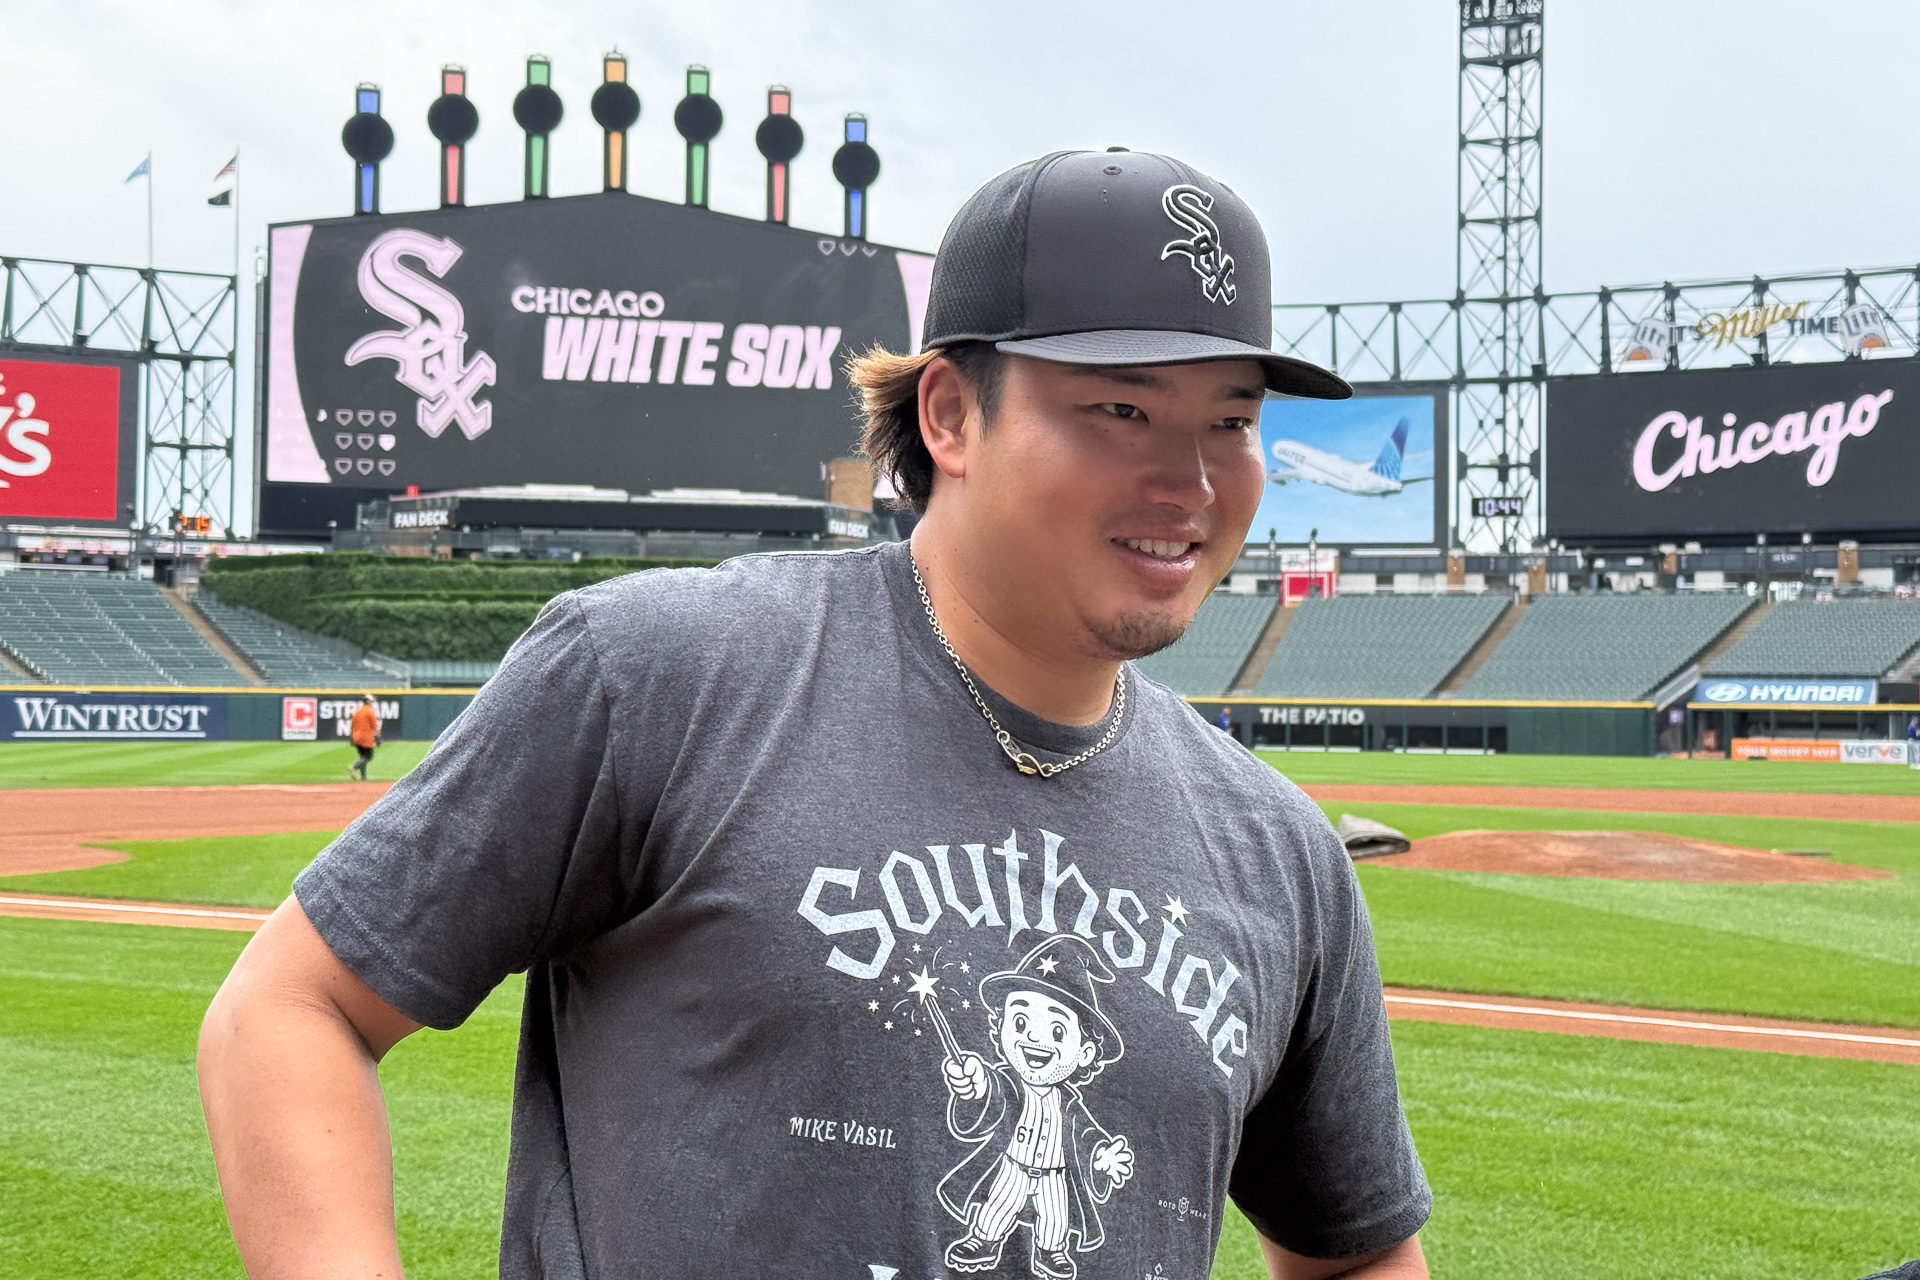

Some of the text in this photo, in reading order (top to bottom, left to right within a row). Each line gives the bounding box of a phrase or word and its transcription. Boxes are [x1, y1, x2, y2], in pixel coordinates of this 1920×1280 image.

[511, 286, 666, 318] CHICAGO
[1697, 301, 1808, 350] Miller
[1788, 316, 1839, 336] TIME
[542, 316, 842, 390] WHITE SOX
[1633, 389, 1894, 492] Chicago
[394, 509, 449, 528] FAN DECK
[1478, 498, 1522, 515] 10:44
[1750, 684, 1865, 702] HYUNDAI
[14, 698, 208, 732] WINTRUST
[1259, 707, 1365, 726] THE PATIO
[797, 827, 1249, 1079] Southside
[790, 1116, 897, 1149] MIKE VASIL
[1017, 1126, 1034, 1145] 61
[1158, 1199, 1176, 1211] ROTO
